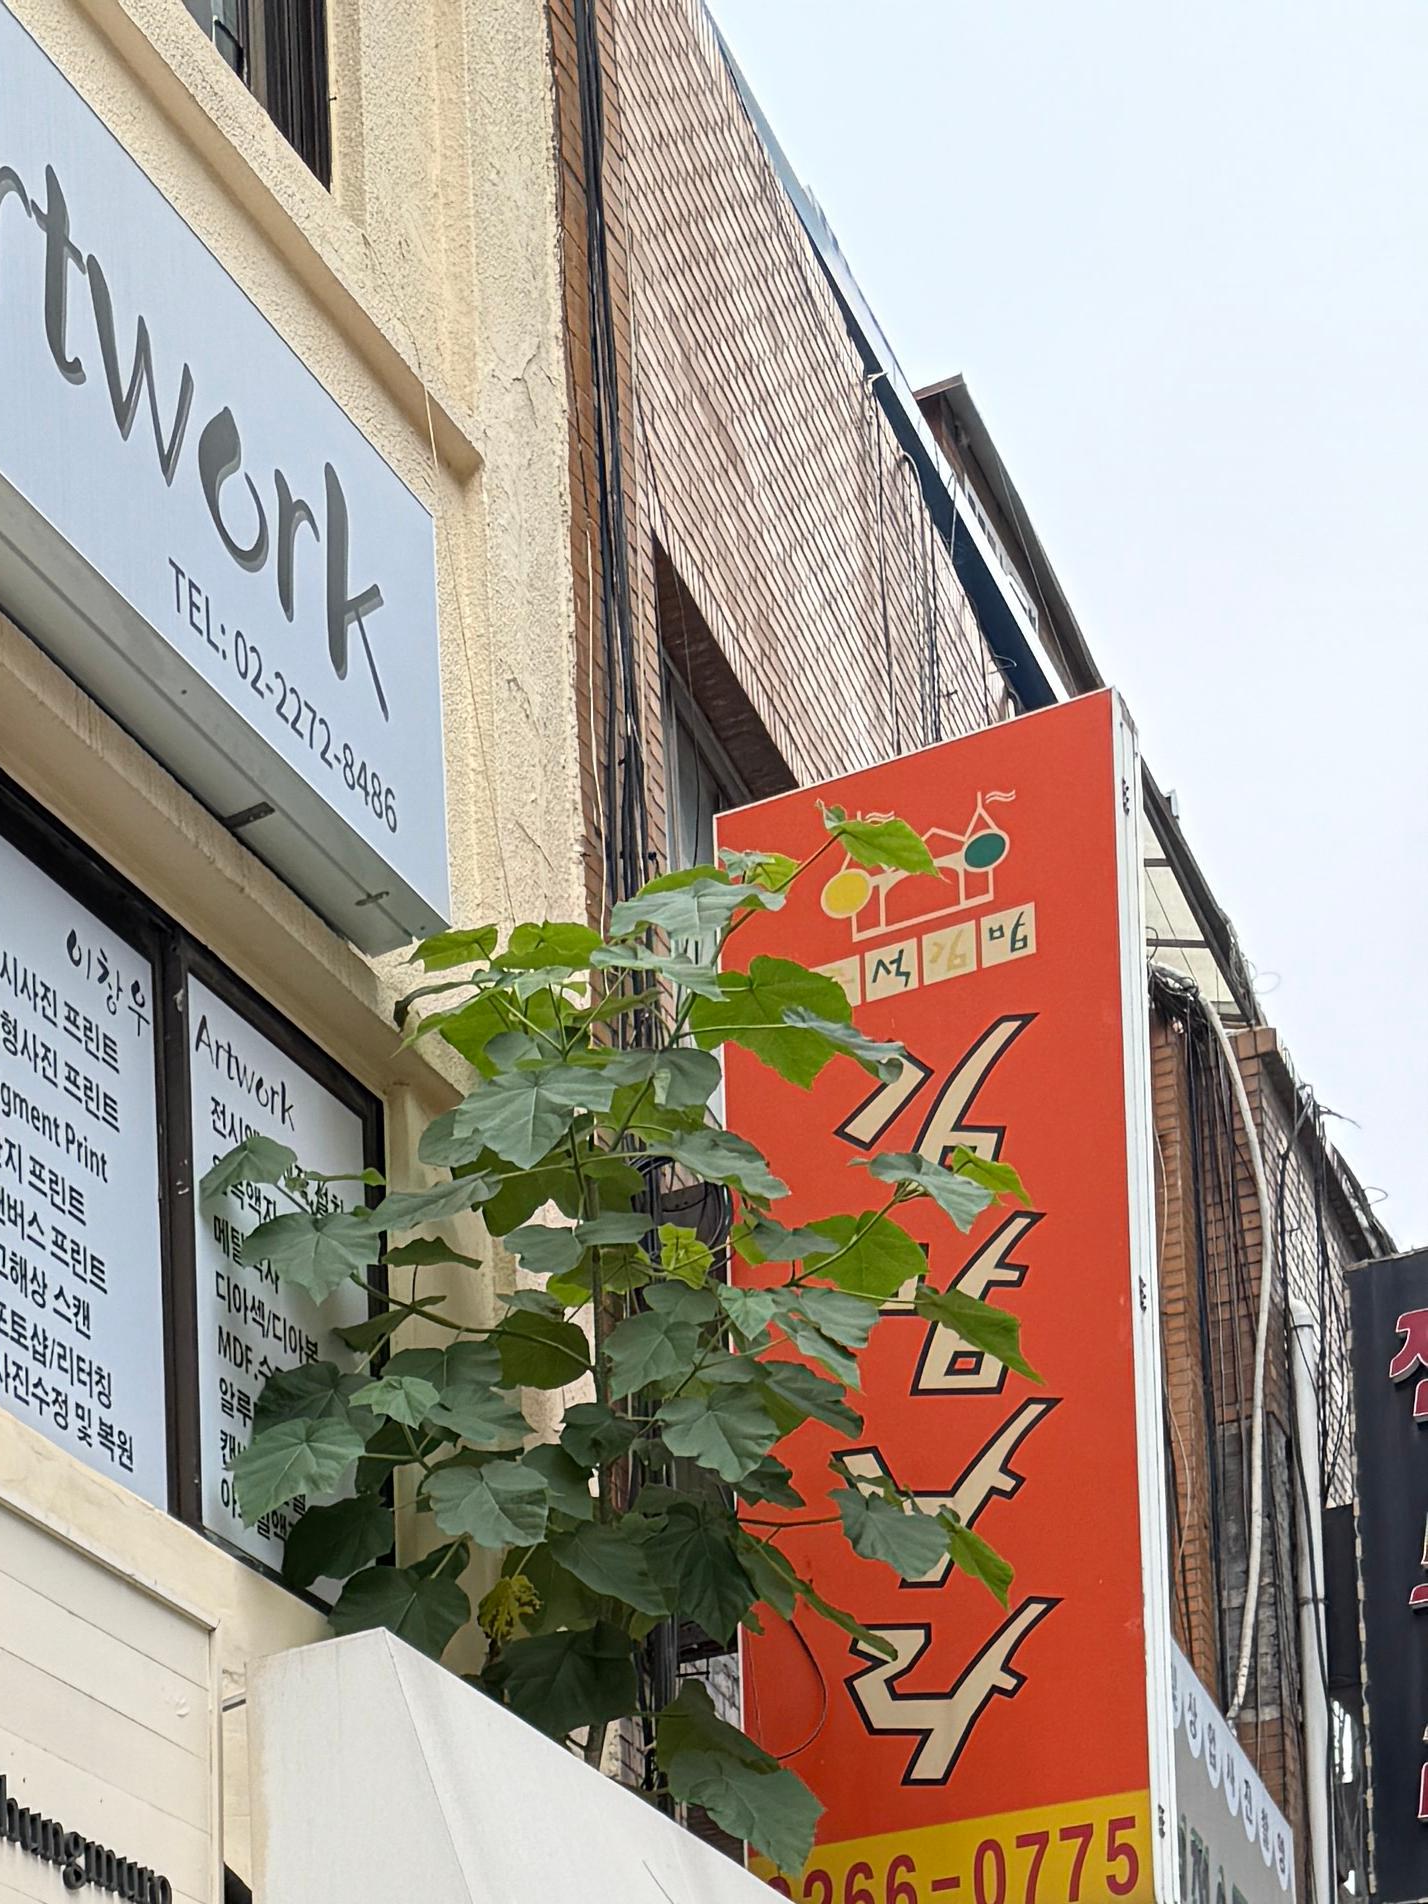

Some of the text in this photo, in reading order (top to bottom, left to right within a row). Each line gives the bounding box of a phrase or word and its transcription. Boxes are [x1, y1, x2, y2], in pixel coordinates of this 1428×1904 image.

[167, 556, 401, 836] TEL: 02-2272-8486
[62, 999, 120, 1075] 프린트
[63, 1061, 121, 1134] 프린트
[195, 1014, 297, 1133] Artwork
[63, 1118, 109, 1184] Print
[29, 1159, 86, 1227] 프린트
[50, 1224, 108, 1296] 프린트
[53, 1282, 92, 1341] 스캔
[75, 1408, 93, 1450] 및
[97, 1420, 135, 1474] 복원
